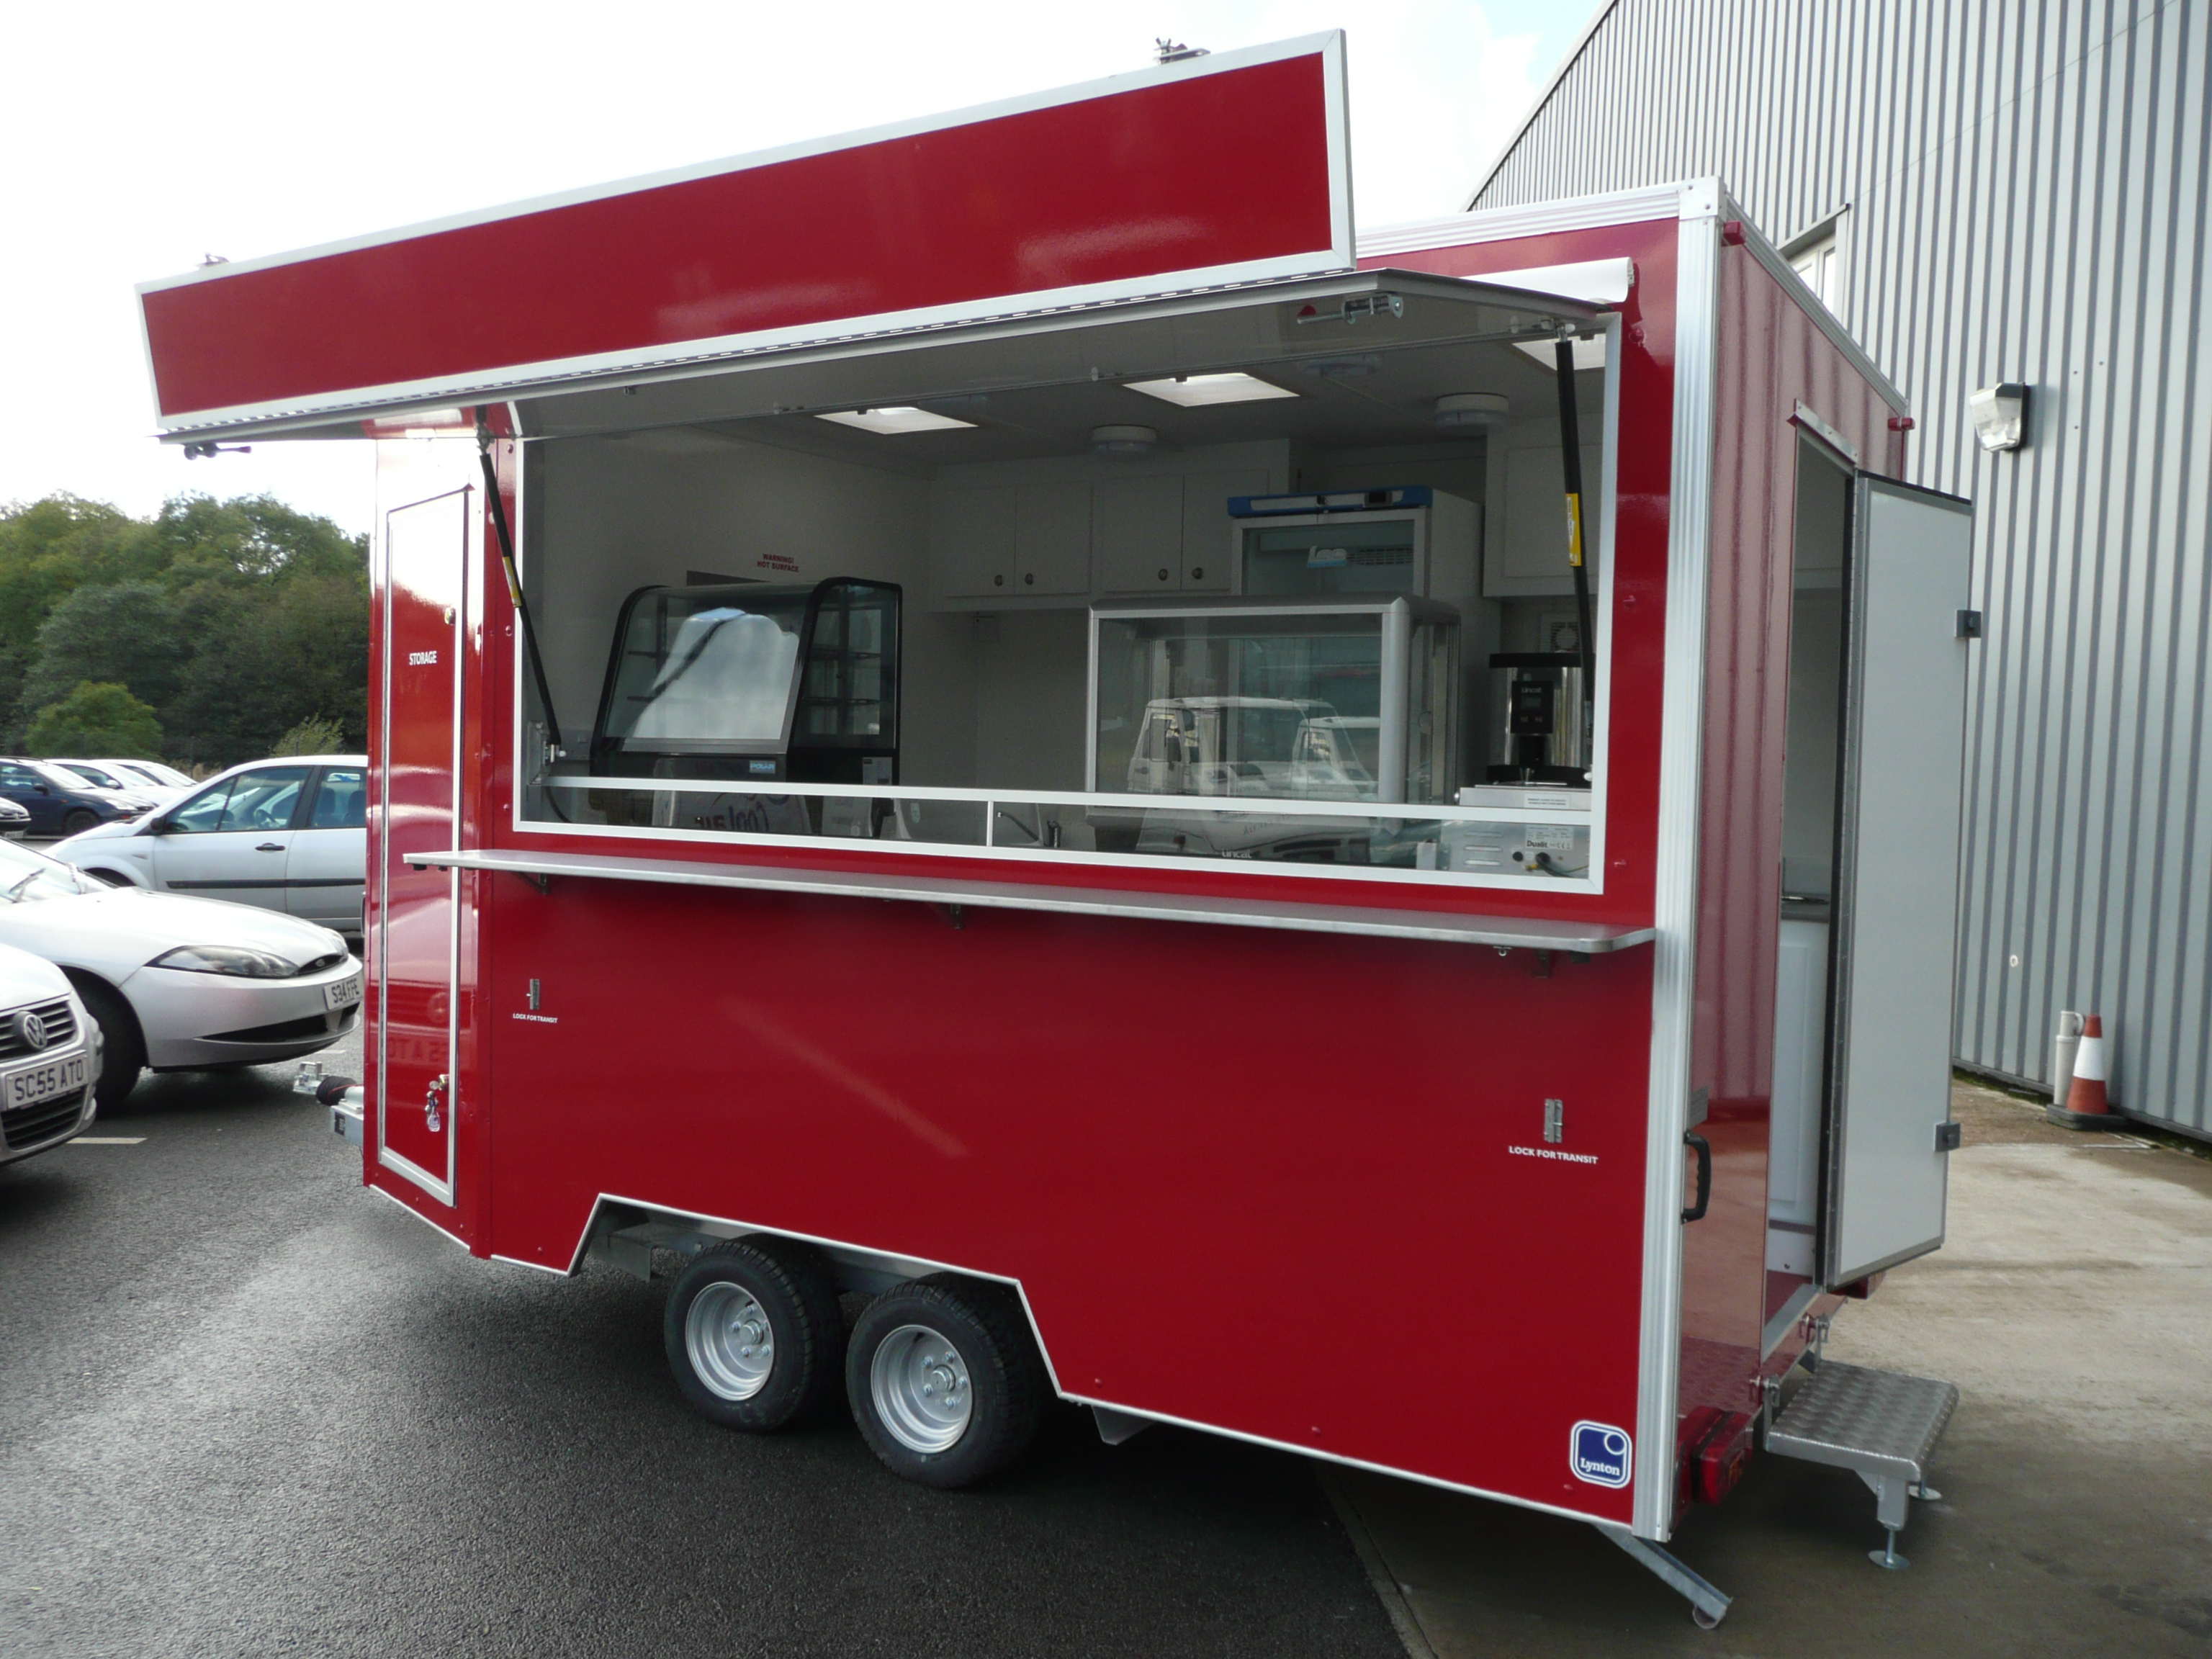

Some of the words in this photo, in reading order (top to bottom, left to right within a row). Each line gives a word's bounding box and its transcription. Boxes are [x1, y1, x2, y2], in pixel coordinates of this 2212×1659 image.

[757, 560, 770, 569] HOT
[772, 562, 799, 573] SURFACE
[409, 650, 437, 666] STORAGE
[14, 1068, 55, 1101] SC55
[60, 1058, 84, 1088] ATO
[1509, 1146, 1535, 1156] LOCK
[1537, 1149, 1556, 1159] FOR
[1557, 1152, 1599, 1164] TRANSIT
[1581, 1457, 1620, 1476] Lynton
